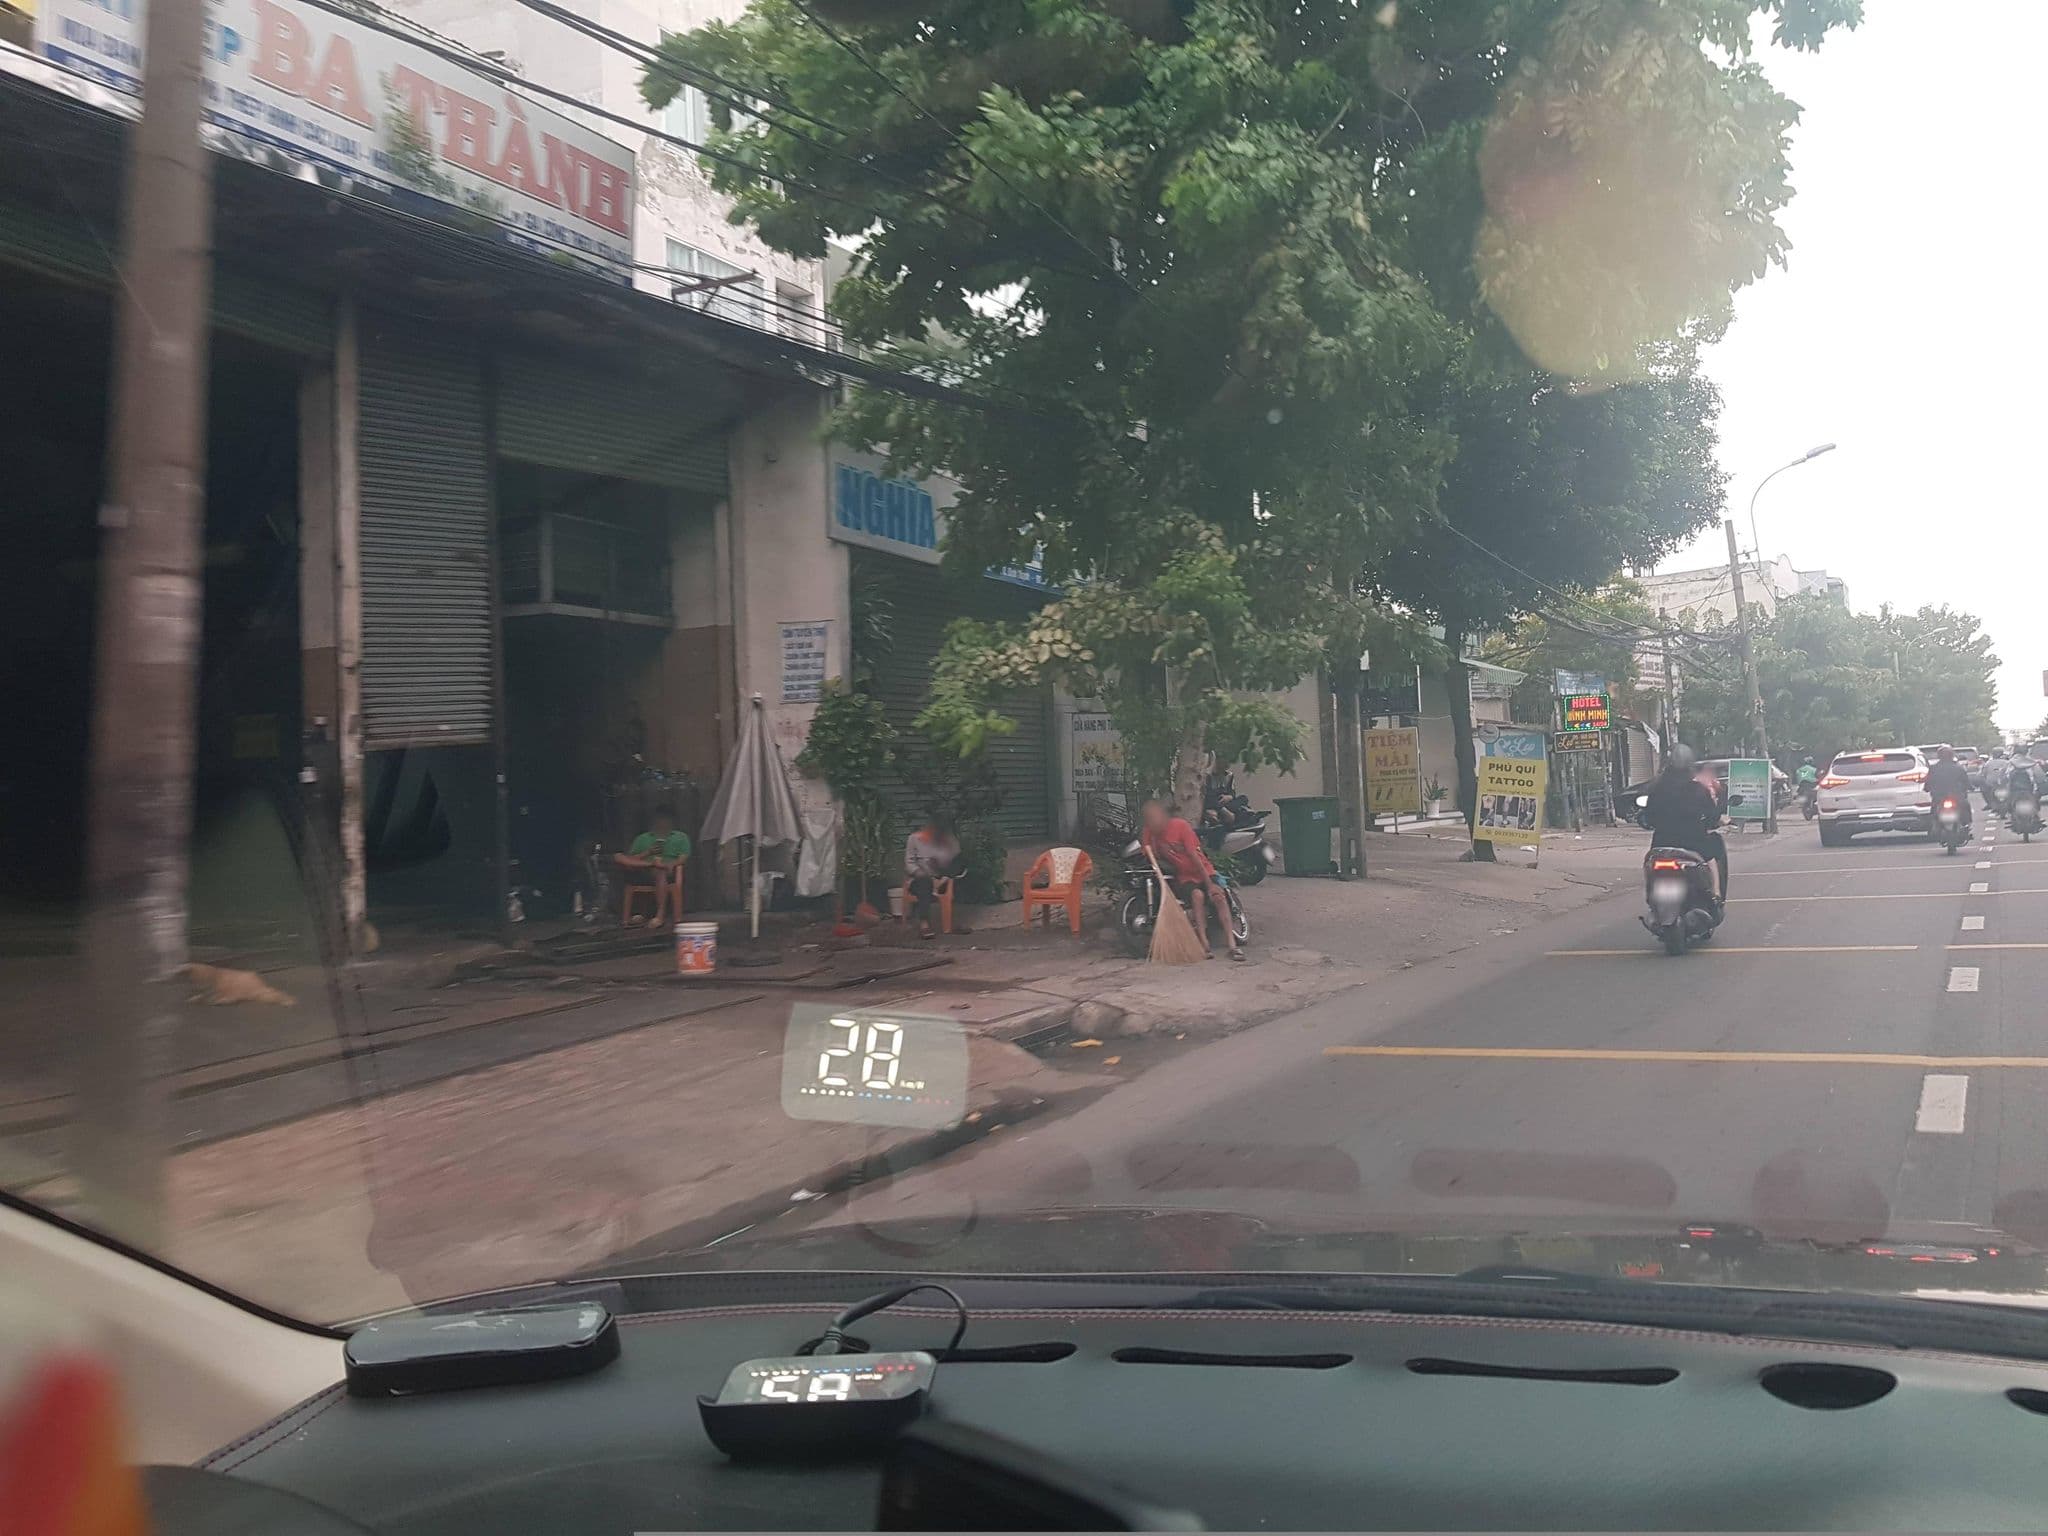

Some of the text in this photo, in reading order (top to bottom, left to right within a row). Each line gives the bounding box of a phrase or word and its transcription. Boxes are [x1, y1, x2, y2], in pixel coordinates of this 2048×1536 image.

[249, 0, 632, 239] BA THÀNH
[1571, 697, 1602, 708] HOTEL
[1588, 709, 1608, 720] MINH
[1488, 776, 1534, 787] TATTOO
[817, 1018, 904, 1090] 28
